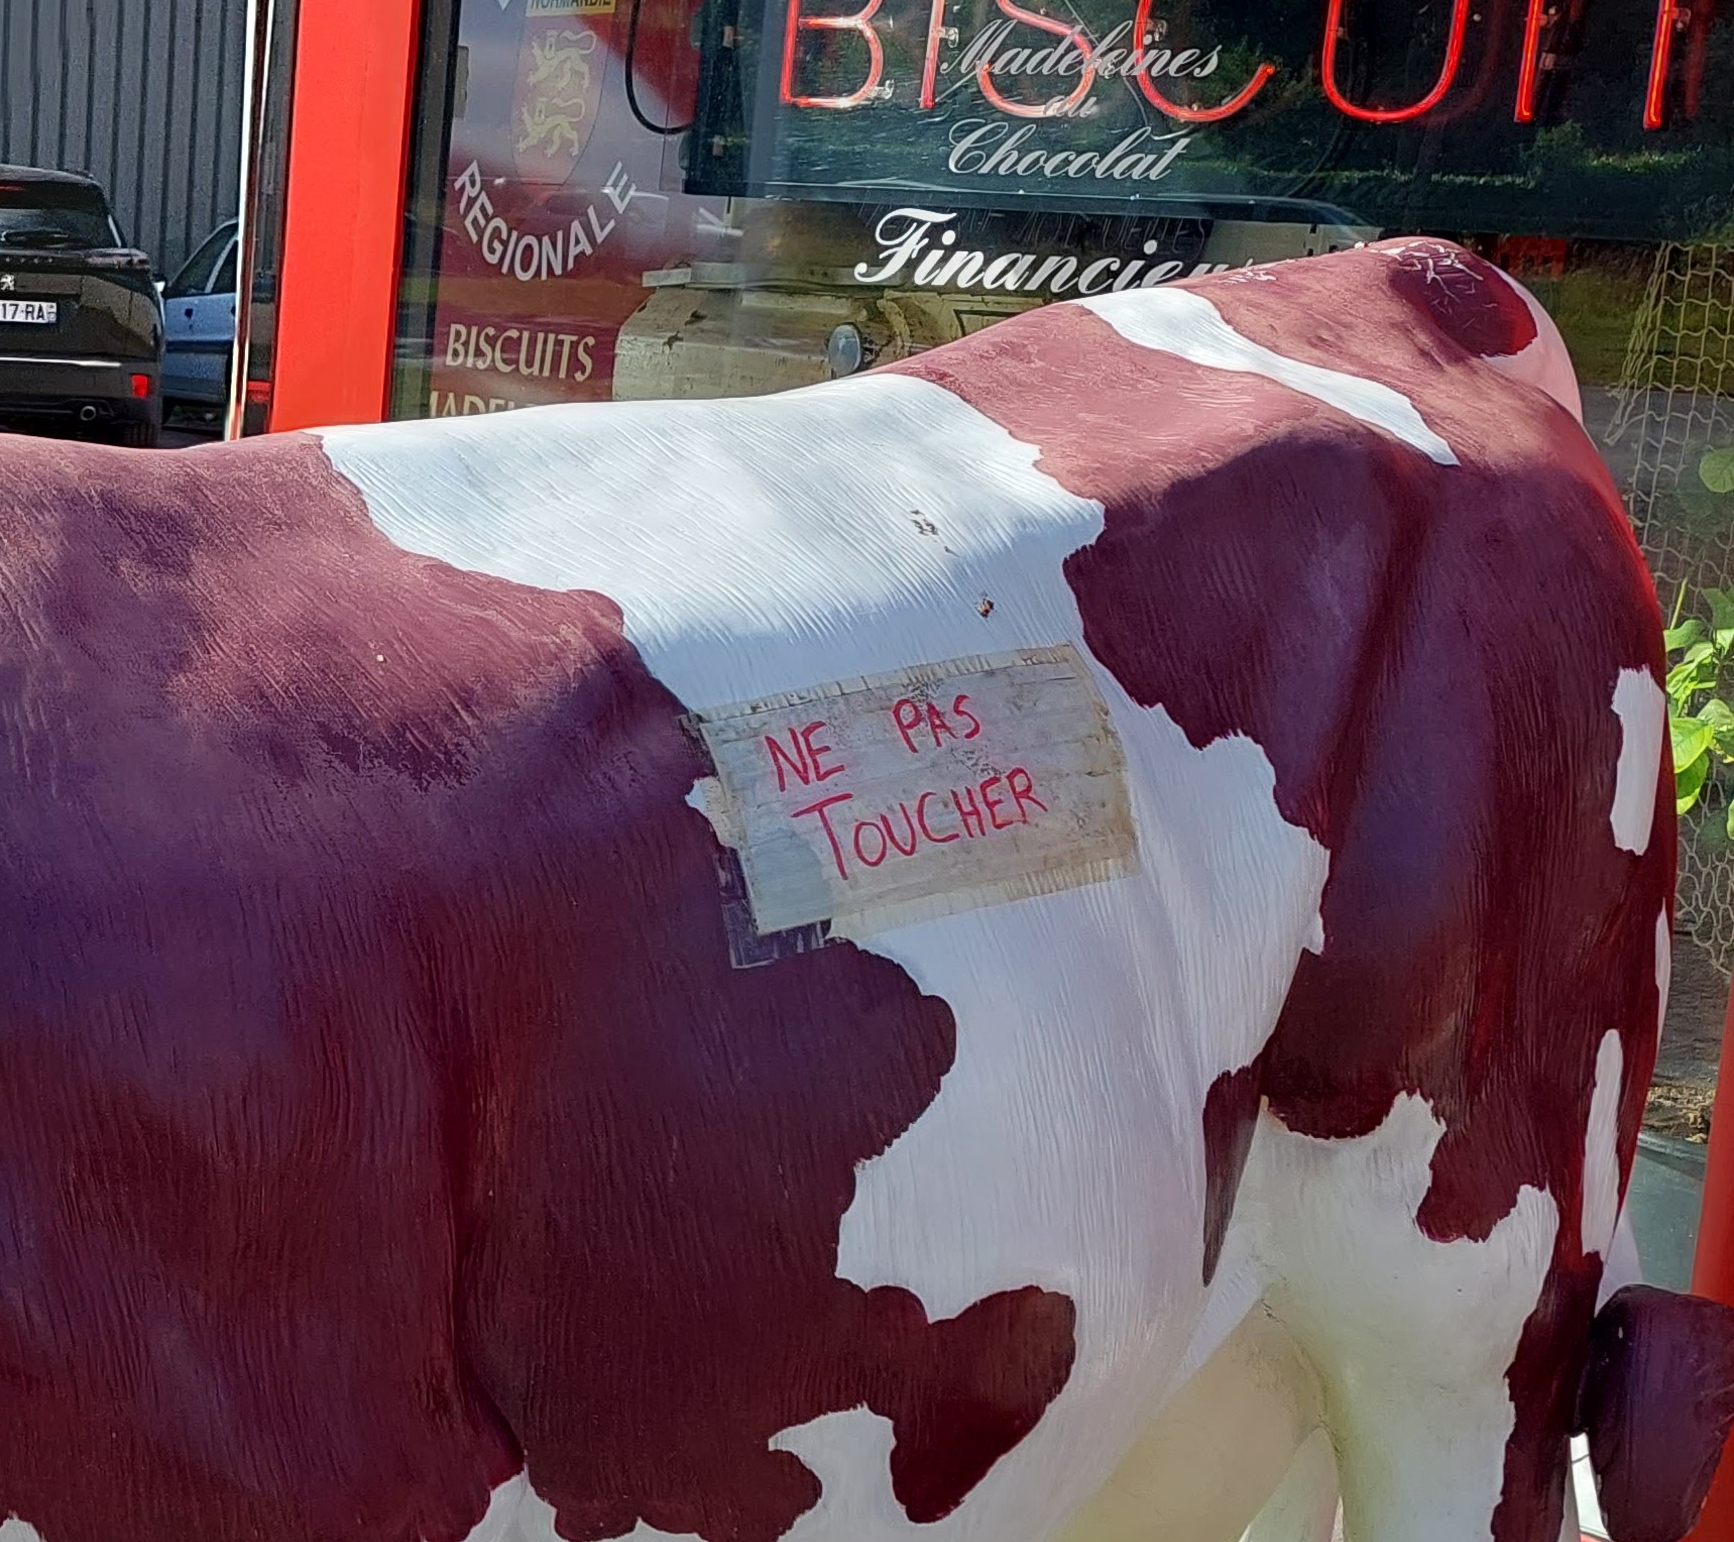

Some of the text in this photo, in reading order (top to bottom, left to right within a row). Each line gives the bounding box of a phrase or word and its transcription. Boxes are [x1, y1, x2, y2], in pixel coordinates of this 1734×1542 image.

[939, 19, 1223, 79] Madeleines
[948, 119, 1194, 181] Chocolat
[454, 159, 637, 281] REGIONALE
[854, 207, 1254, 295] Financie
[445, 323, 596, 383] BISCUITS
[765, 694, 982, 792] NE PAS
[791, 766, 1048, 881] TOUCHER
